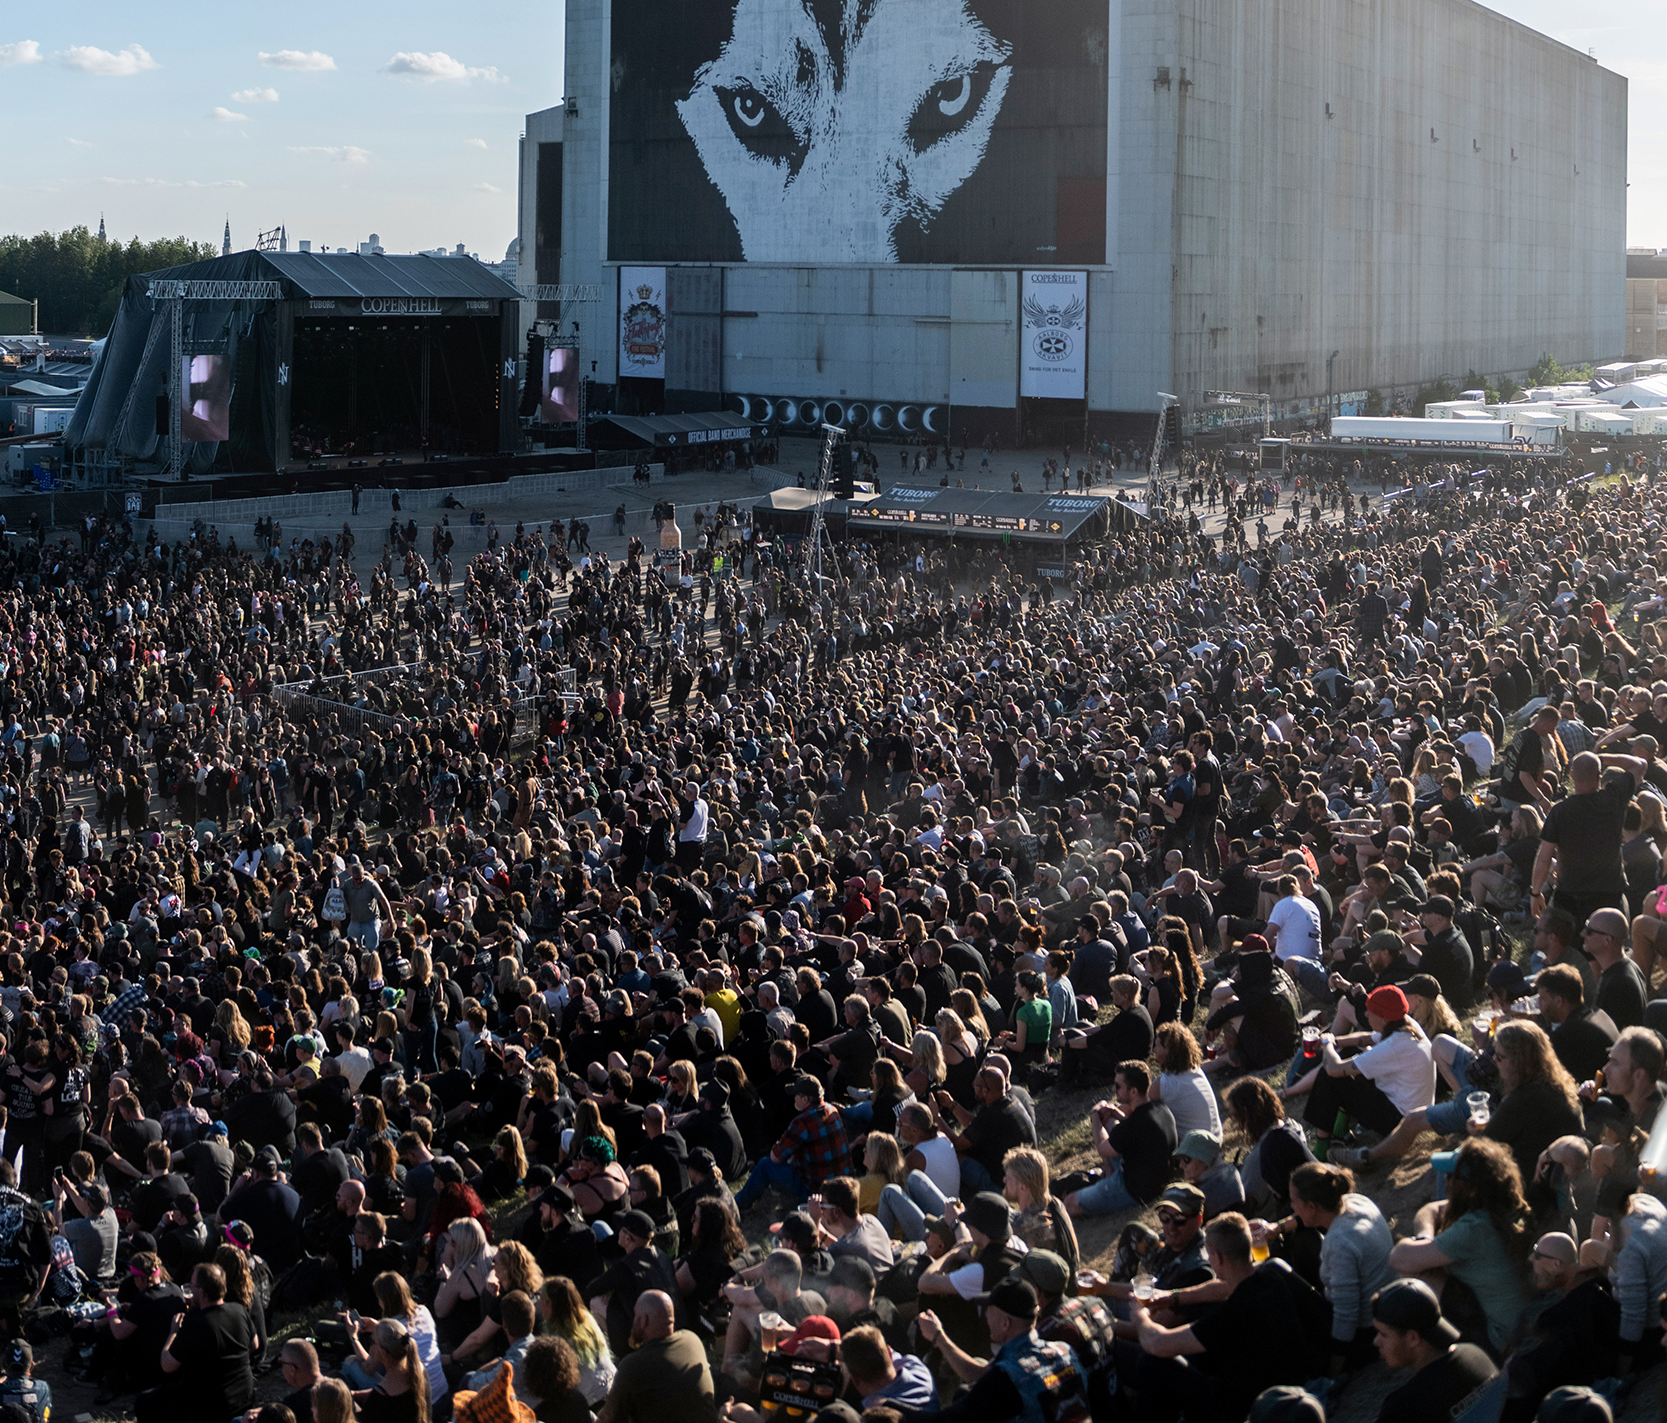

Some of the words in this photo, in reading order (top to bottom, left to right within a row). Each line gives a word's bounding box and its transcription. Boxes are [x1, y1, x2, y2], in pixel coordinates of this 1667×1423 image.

[1031, 273, 1077, 284] COPENHELL
[309, 300, 335, 309] TUBORG
[361, 297, 443, 315] COPENHELL
[465, 301, 489, 309] TUBORG
[1037, 331, 1068, 341] AALBORG
[1037, 351, 1068, 361] AKVAVIT
[688, 431, 707, 443] OFFICIAL
[708, 429, 720, 441] BAND
[721, 427, 751, 440] MERCHANDISE
[890, 487, 938, 498] TUBORG
[1047, 498, 1101, 508] TUBORG
[1037, 568, 1064, 578] TUBORG
